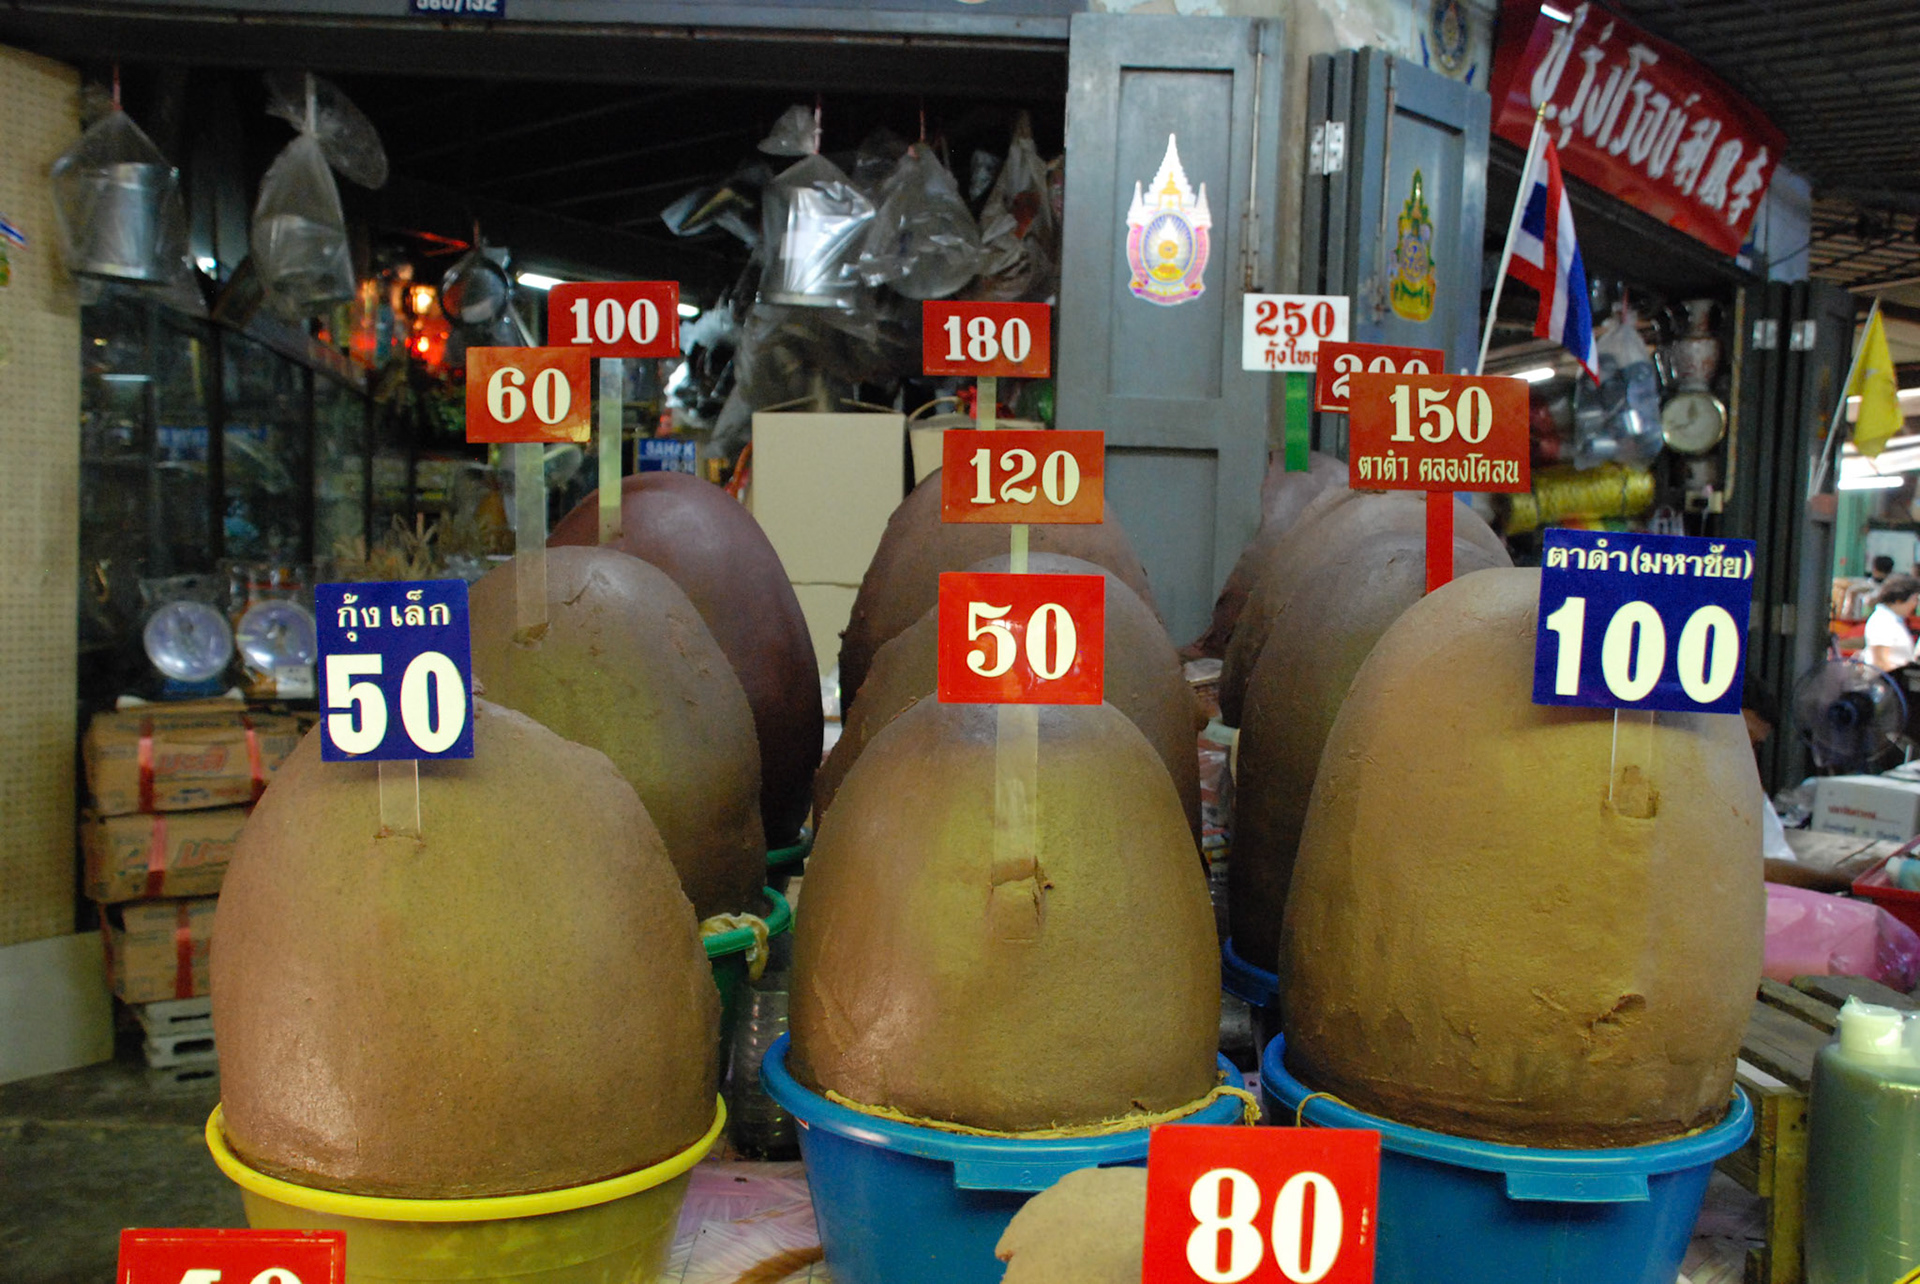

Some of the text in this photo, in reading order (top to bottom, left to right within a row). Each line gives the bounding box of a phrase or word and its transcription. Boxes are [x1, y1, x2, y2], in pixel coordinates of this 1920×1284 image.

[570, 298, 659, 344] 100
[943, 315, 1031, 362] 180
[1255, 301, 1335, 338] 250
[487, 367, 571, 424] 60
[1389, 384, 1493, 444] 150
[969, 448, 1080, 506] 120
[1359, 450, 1520, 484] ตาดำ คลองโคลน
[1546, 539, 1753, 580] ตาดำ(มหาชัย)
[337, 589, 450, 642] กุ้ง เล็ก
[967, 602, 1077, 680] 50
[1546, 596, 1740, 704] 100
[326, 651, 466, 754] 50
[1186, 1168, 1343, 1284] 80
